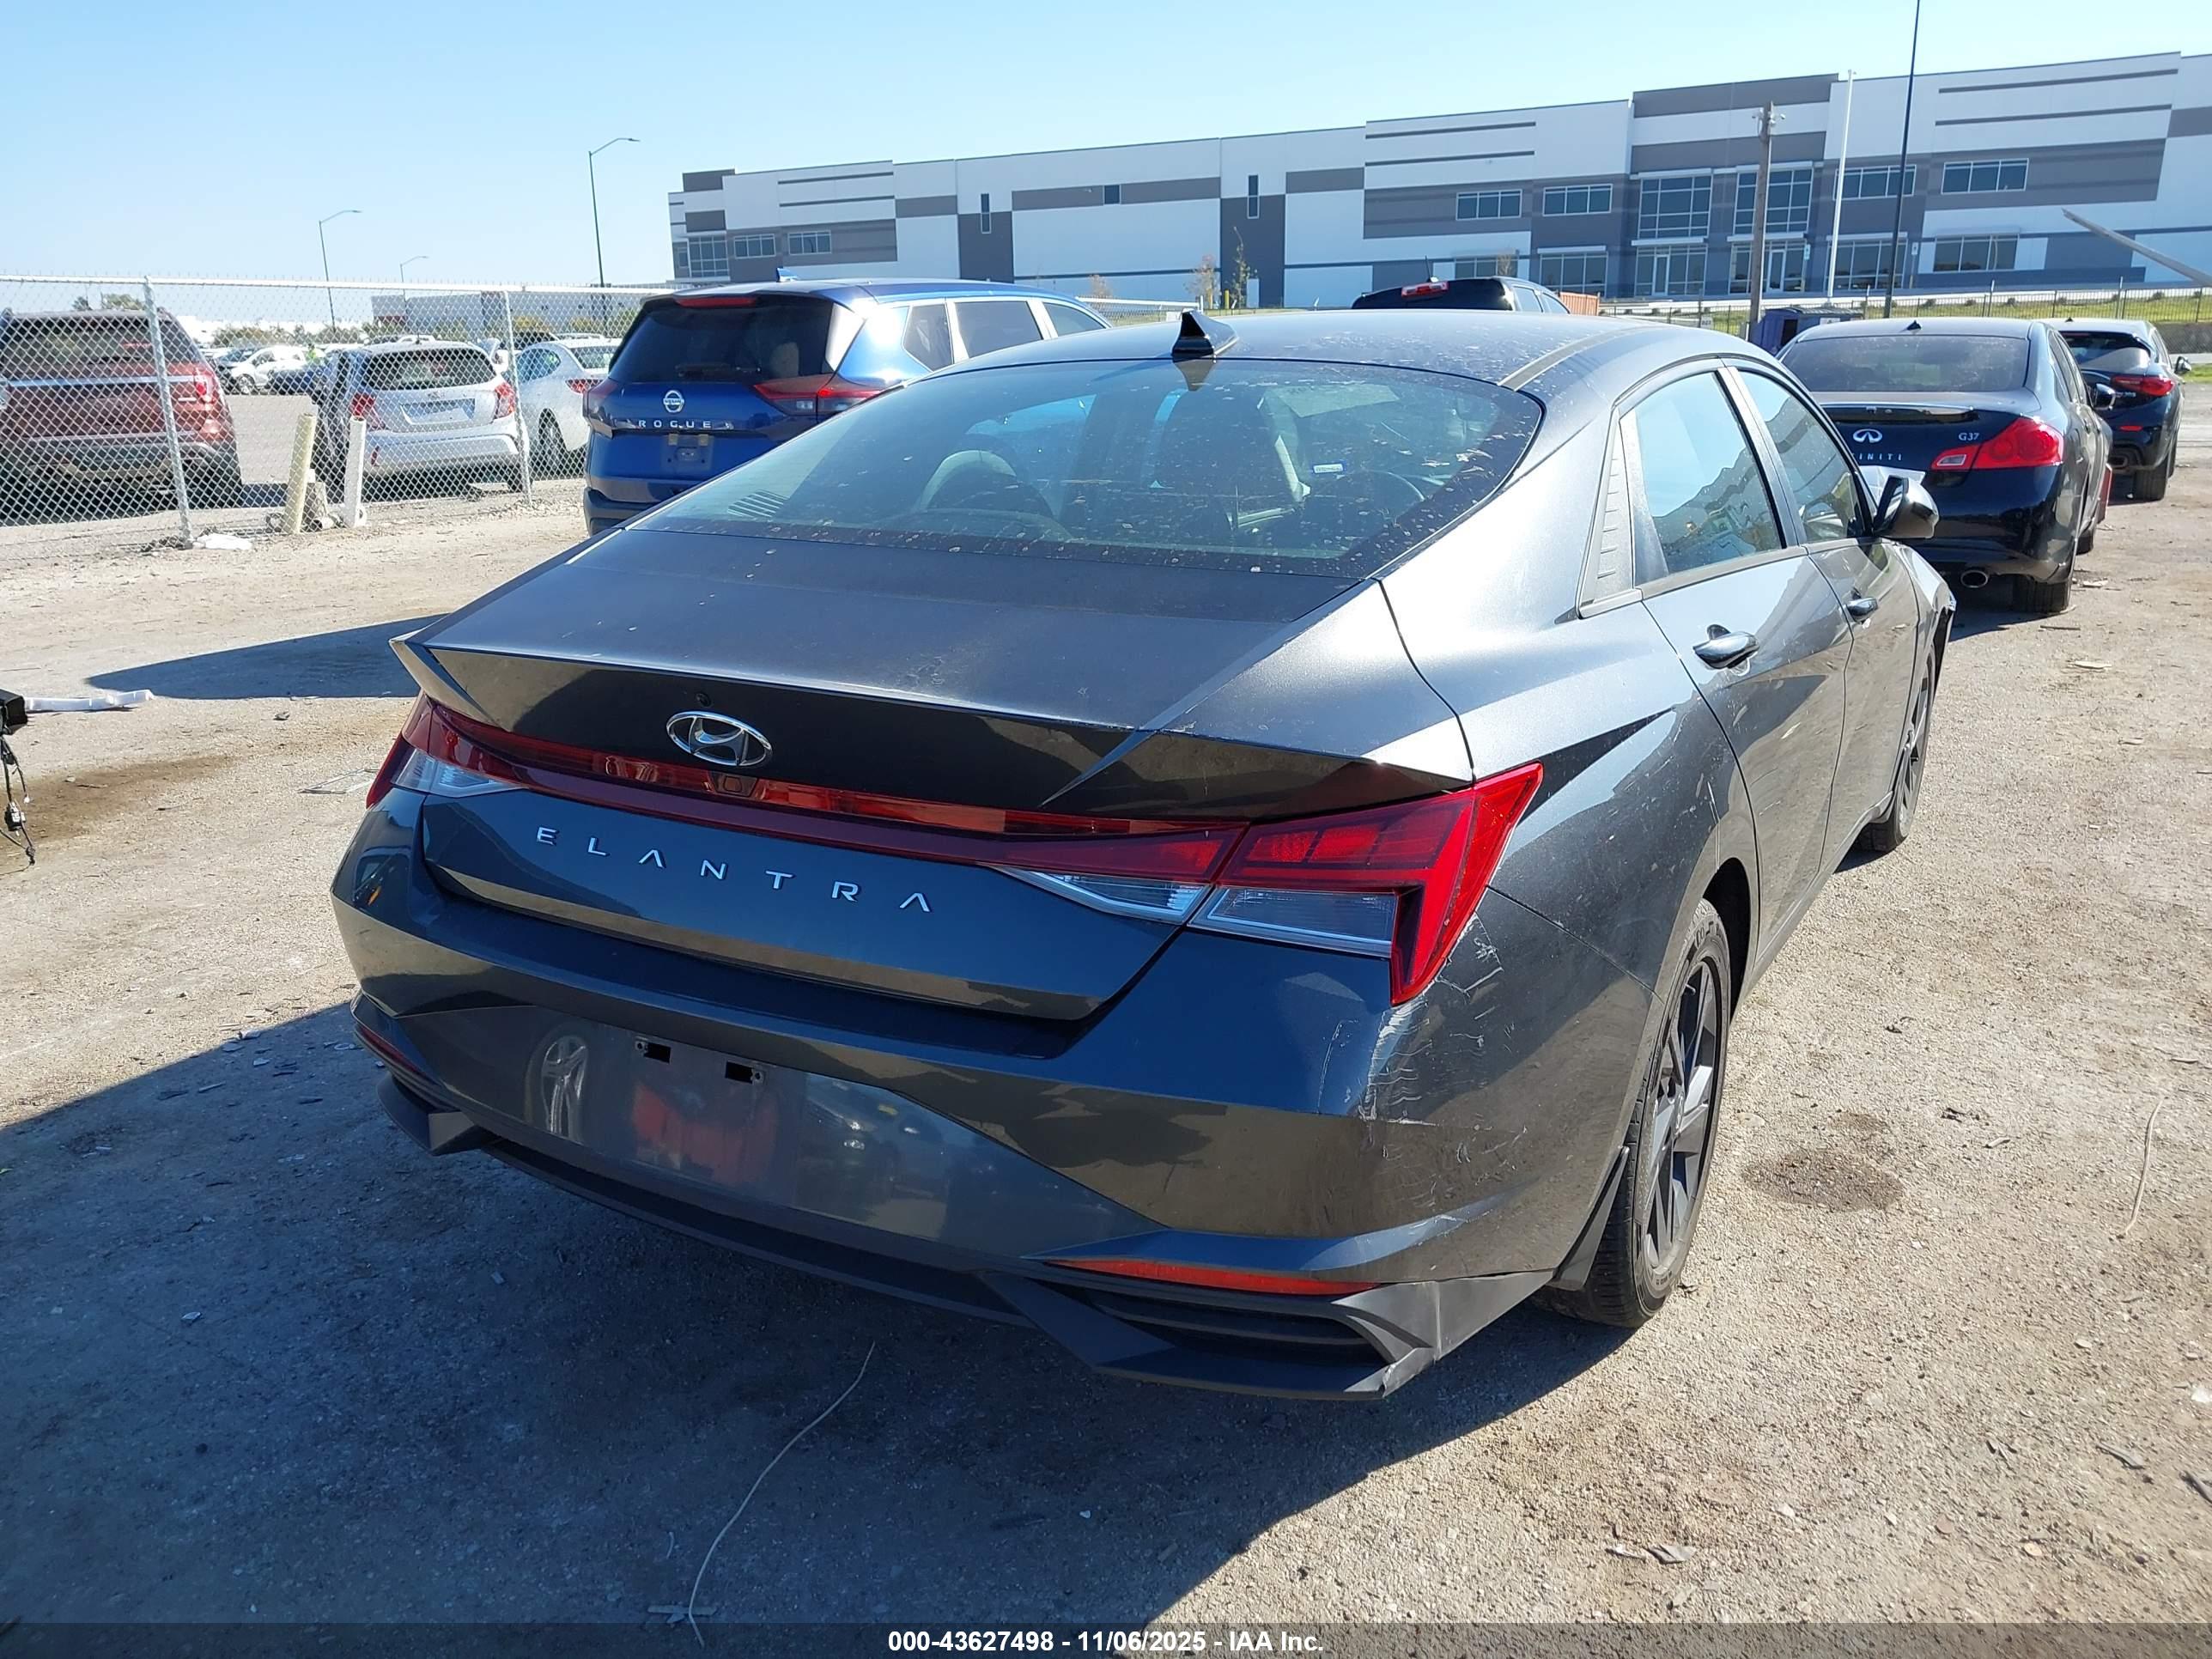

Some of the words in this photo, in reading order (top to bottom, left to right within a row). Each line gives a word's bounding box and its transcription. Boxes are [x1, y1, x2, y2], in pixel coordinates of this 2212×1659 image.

[638, 420, 712, 428] ROGUE
[1958, 432, 1979, 441] G37
[1851, 453, 1902, 461] INITI
[536, 826, 932, 913] ELANTRA
